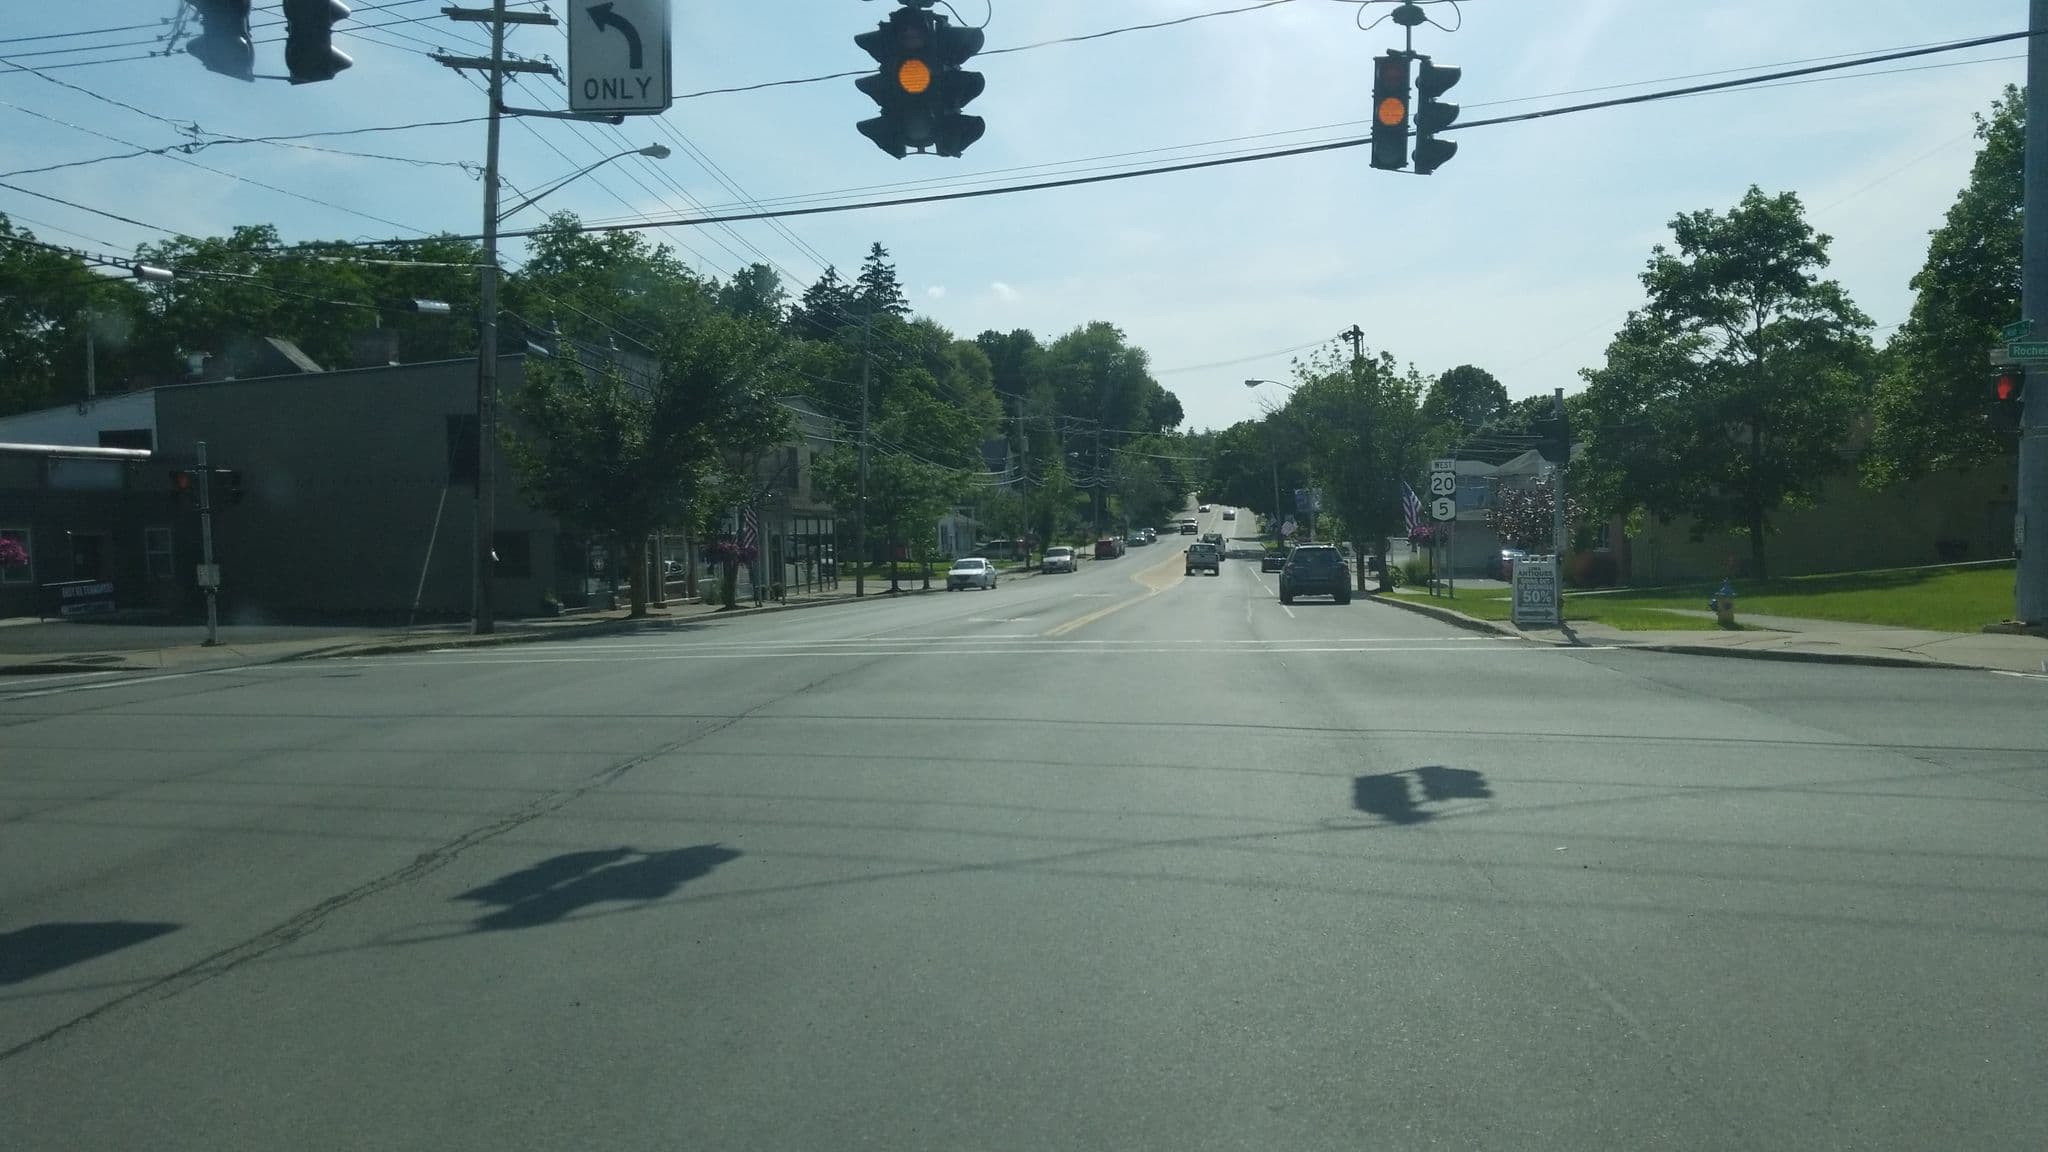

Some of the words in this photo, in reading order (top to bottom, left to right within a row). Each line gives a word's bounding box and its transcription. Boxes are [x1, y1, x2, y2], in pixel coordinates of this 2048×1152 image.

[584, 76, 652, 100] ONLY
[1433, 477, 1453, 491] 20
[1439, 503, 1448, 515] 5
[1523, 590, 1552, 602] 50%
